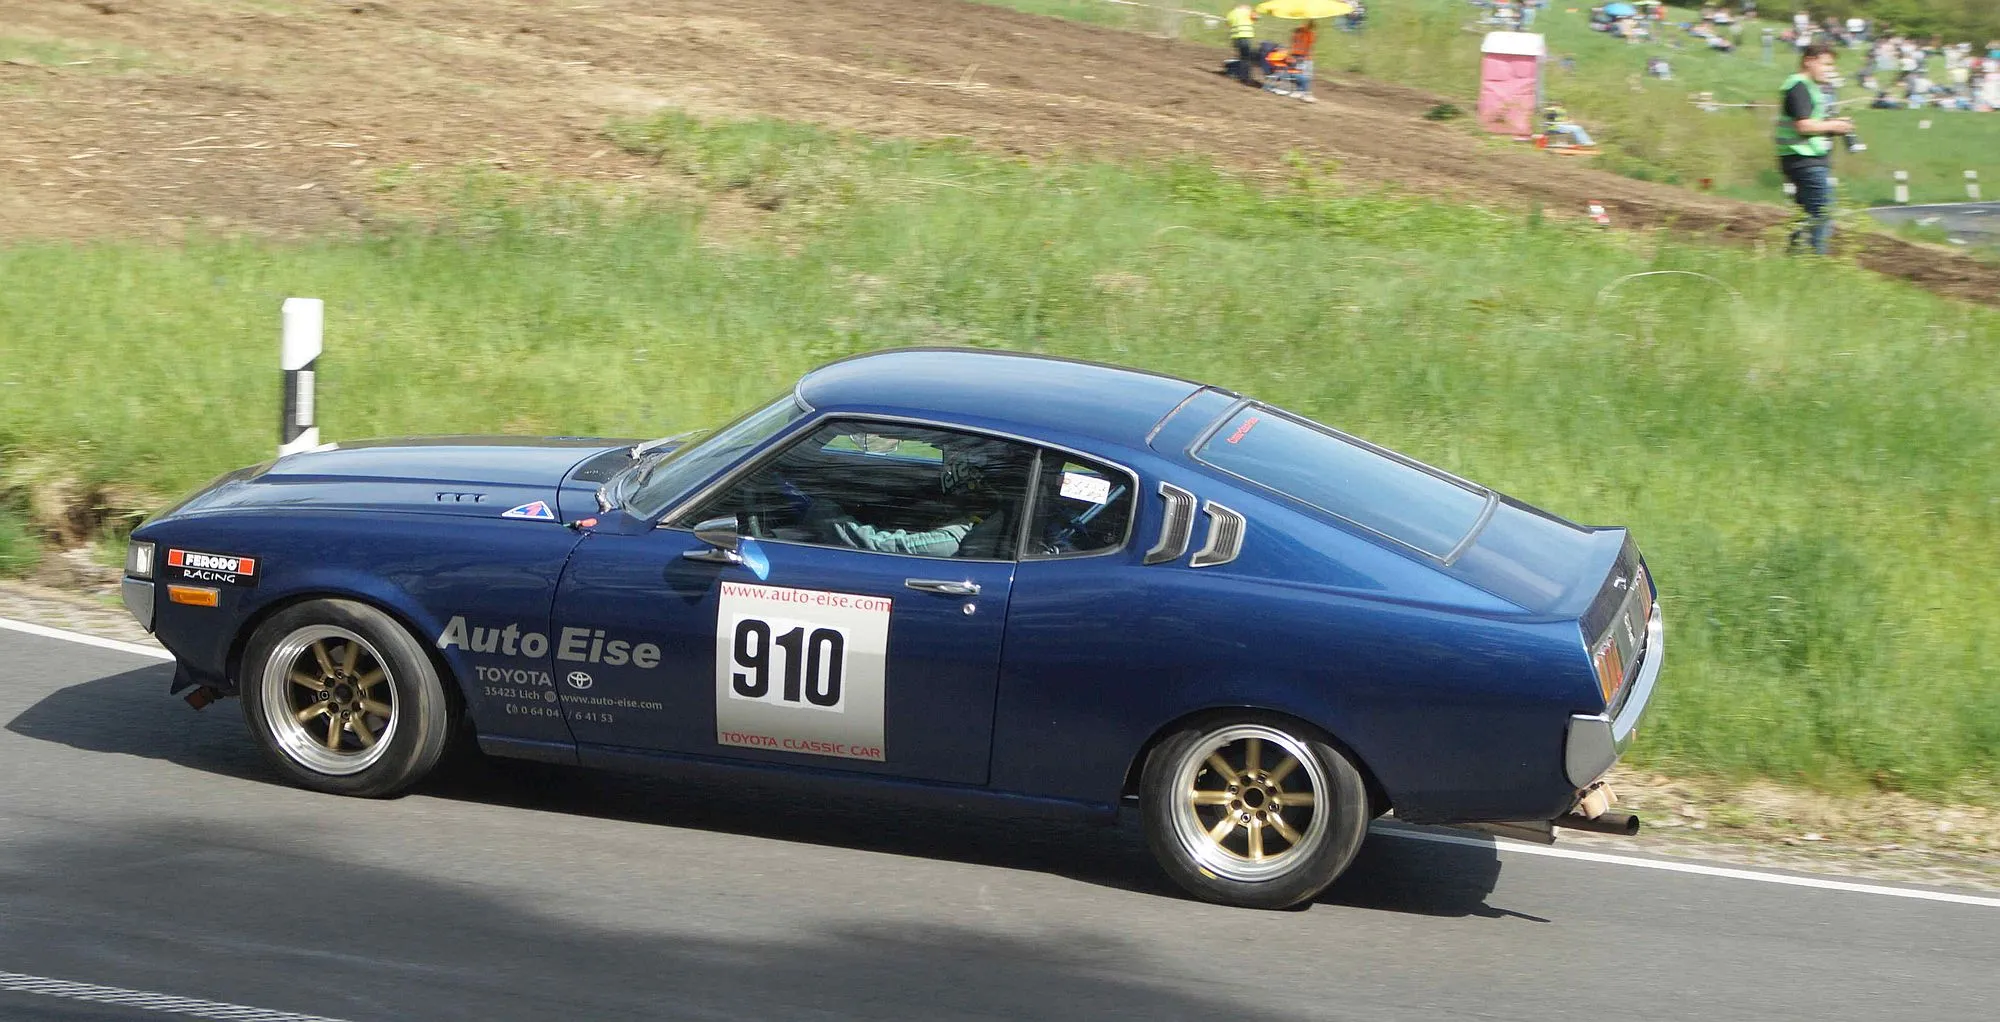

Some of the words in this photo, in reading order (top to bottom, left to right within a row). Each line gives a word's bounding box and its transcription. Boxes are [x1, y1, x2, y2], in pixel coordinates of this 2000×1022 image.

[185, 553, 238, 570] FERODO
[183, 569, 235, 583] RACING
[722, 584, 892, 612] www.auto-eise.com
[436, 615, 549, 658] Auto
[556, 626, 661, 669] Eise
[733, 618, 844, 707] 910
[475, 666, 553, 687] TOYOTA
[484, 686, 516, 698] 35423
[519, 689, 540, 700] Lich
[560, 694, 663, 710] www.auto-eise.com
[722, 731, 778, 748] TOYOTA
[783, 738, 846, 754] CLASSIC
[850, 746, 881, 759] CAR
